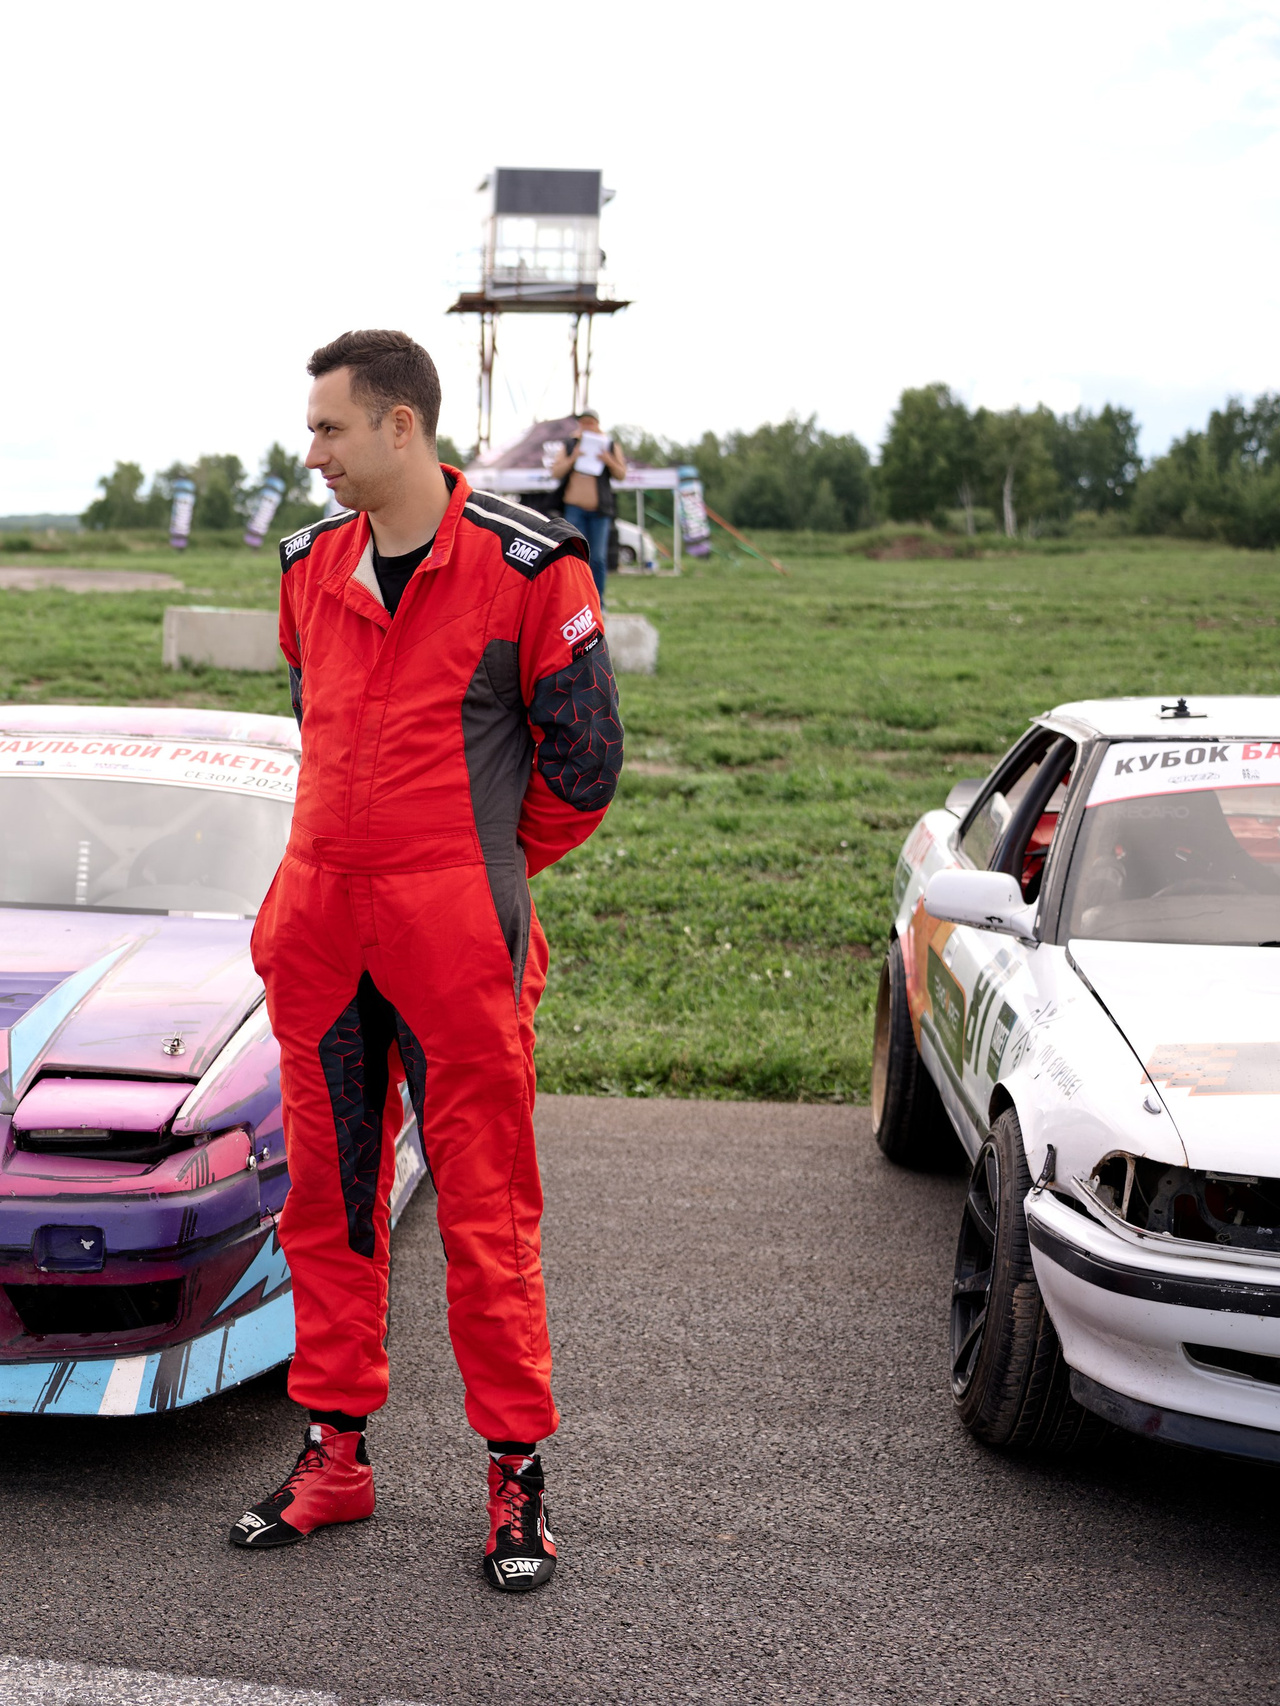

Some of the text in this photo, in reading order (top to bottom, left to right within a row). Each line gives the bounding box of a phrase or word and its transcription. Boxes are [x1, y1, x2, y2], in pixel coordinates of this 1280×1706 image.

[285, 533, 311, 556] OMP
[508, 541, 540, 562] OMP
[562, 609, 593, 641] OMP
[169, 747, 295, 778] РАКЕТЫ
[1113, 744, 1231, 776] КУБОК
[184, 769, 295, 793] СЕЗОН 2025
[1115, 805, 1190, 820] RECARO
